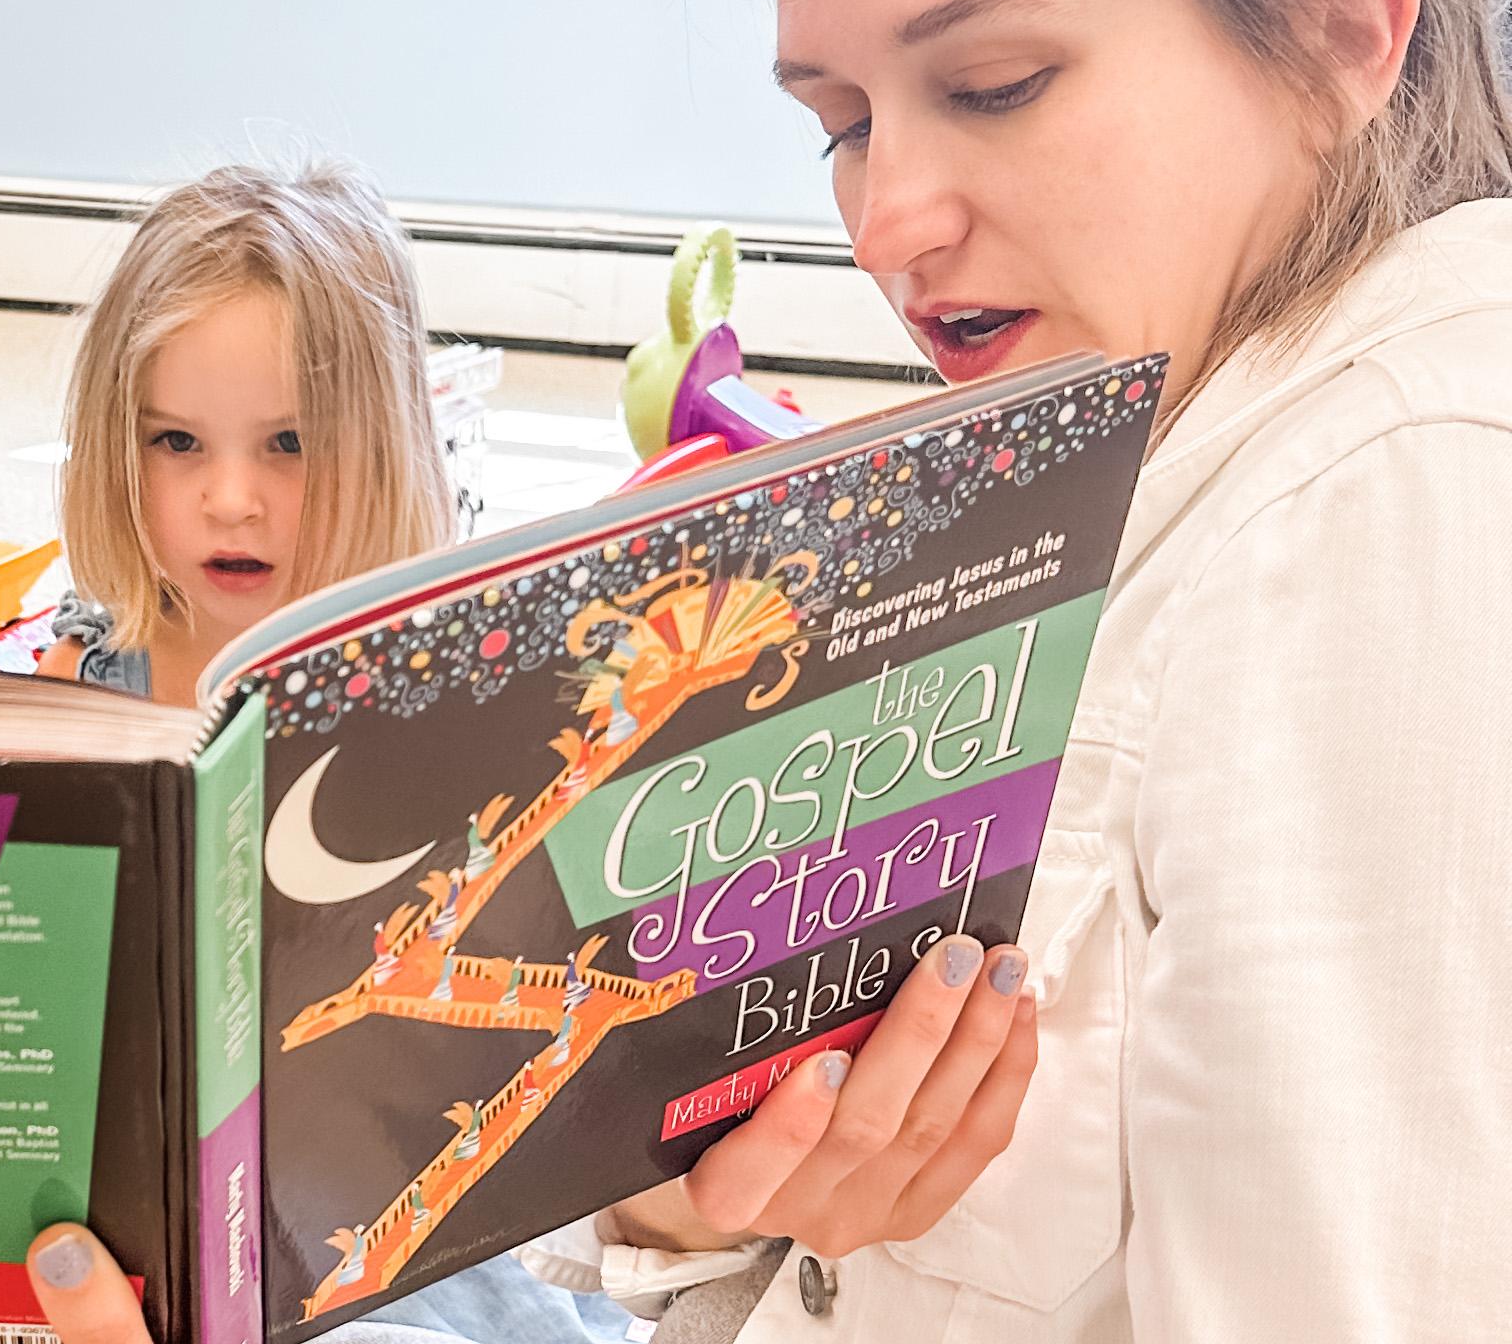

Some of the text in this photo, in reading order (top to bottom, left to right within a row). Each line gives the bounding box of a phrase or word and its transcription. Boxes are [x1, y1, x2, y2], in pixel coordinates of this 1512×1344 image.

[825, 557, 1062, 662] Old and New Testaments
[830, 530, 1067, 636] Discovering Jesus in the
[865, 659, 944, 725] the
[604, 621, 1038, 962] Gospel
[697, 812, 996, 980] Story
[725, 937, 890, 1057] Bible
[19, 1047, 53, 1059] PhD
[670, 1073, 757, 1131] Marty
